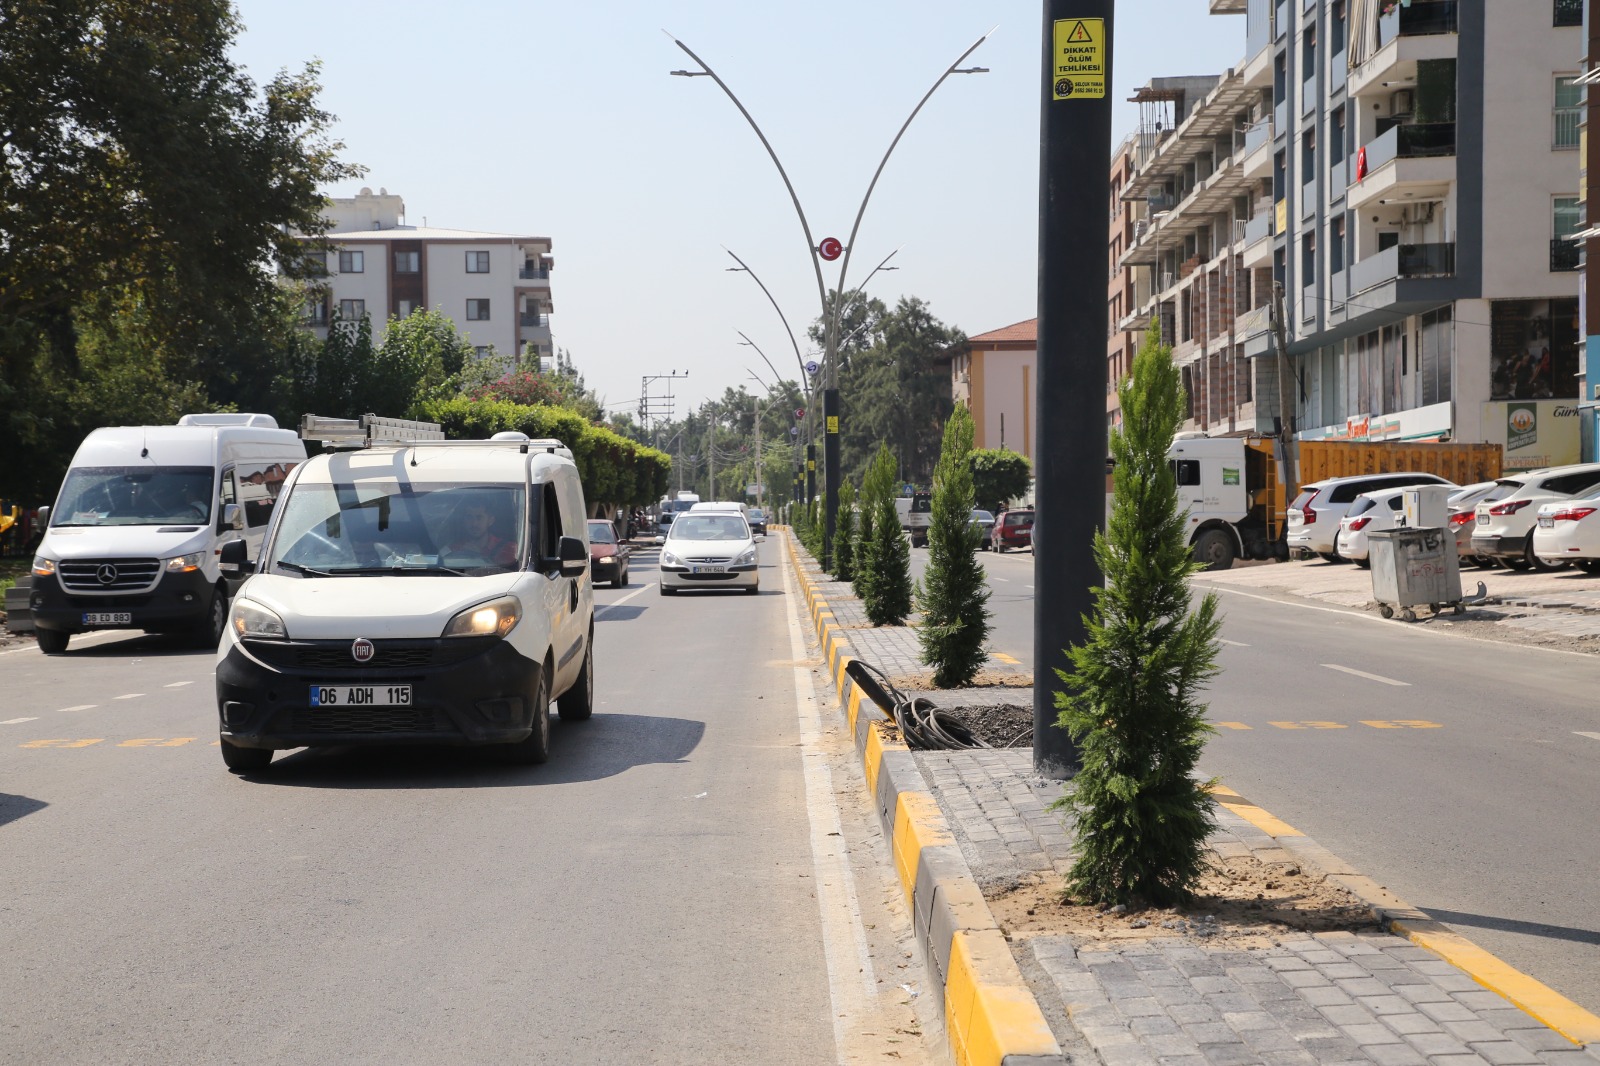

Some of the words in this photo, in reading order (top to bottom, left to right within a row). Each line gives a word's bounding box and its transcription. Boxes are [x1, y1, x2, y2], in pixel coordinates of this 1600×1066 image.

[1058, 64, 1100, 72] TEHLİKESİ
[356, 645, 370, 656] FIAT
[320, 688, 337, 704] 06
[347, 688, 374, 704] ADH
[387, 687, 410, 704] 115
